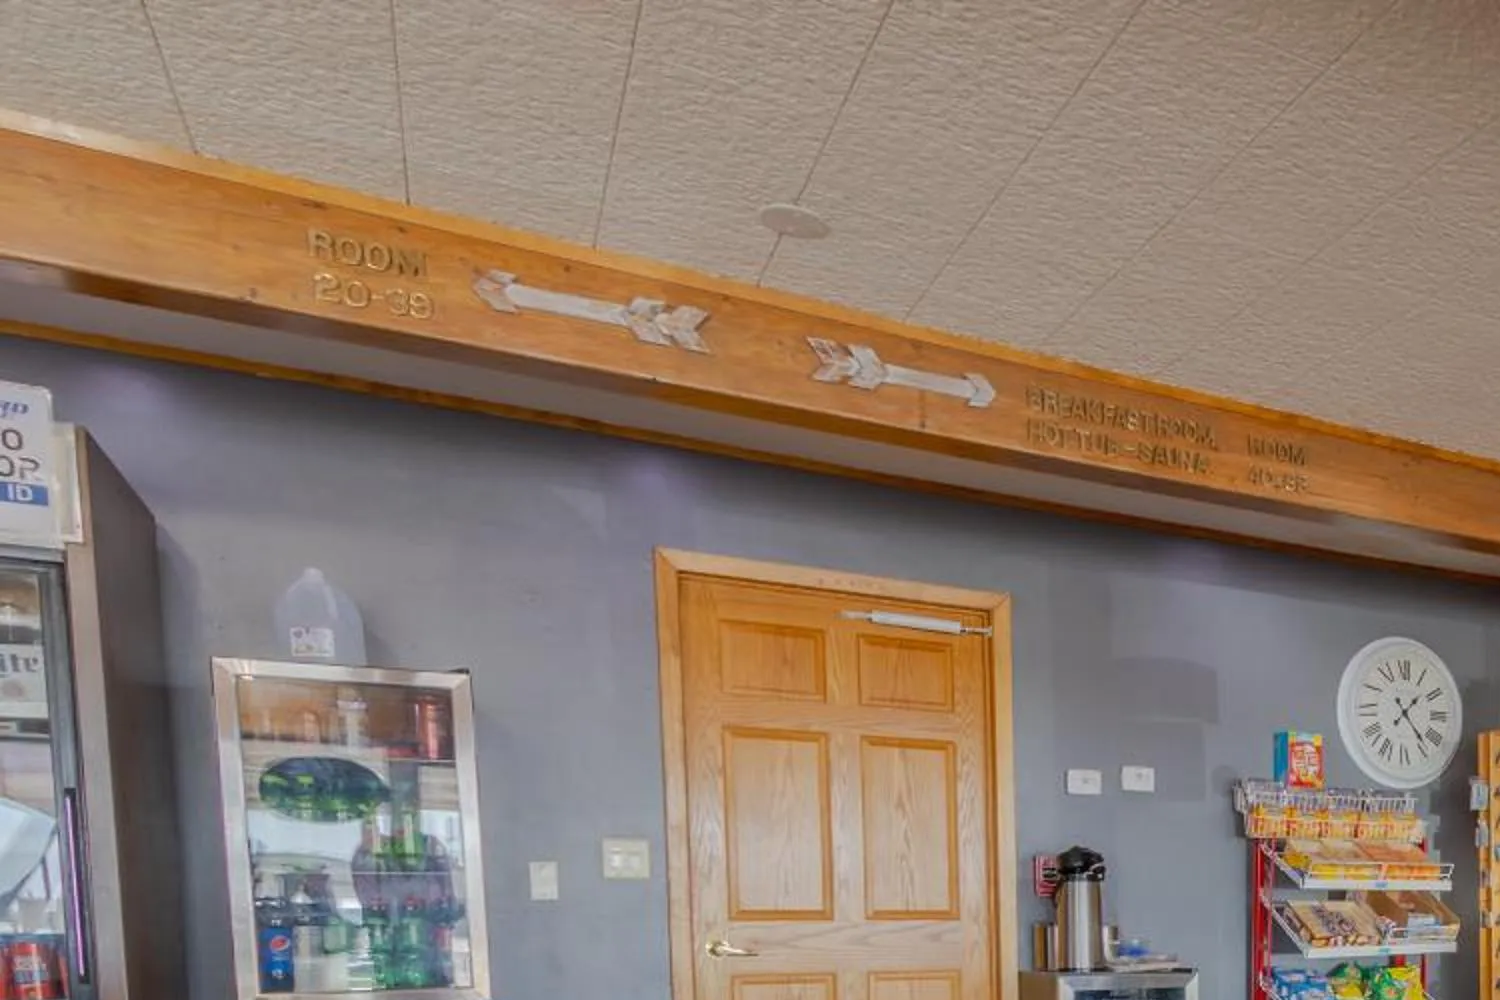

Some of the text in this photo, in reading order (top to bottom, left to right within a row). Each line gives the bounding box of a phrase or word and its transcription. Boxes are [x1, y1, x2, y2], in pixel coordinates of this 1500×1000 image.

[307, 227, 428, 277] ROOM
[313, 272, 435, 319] 20-39
[1025, 386, 1152, 433] BREAKFAST
[1027, 417, 1070, 448] HOT
[1247, 433, 1307, 467] ROOM
